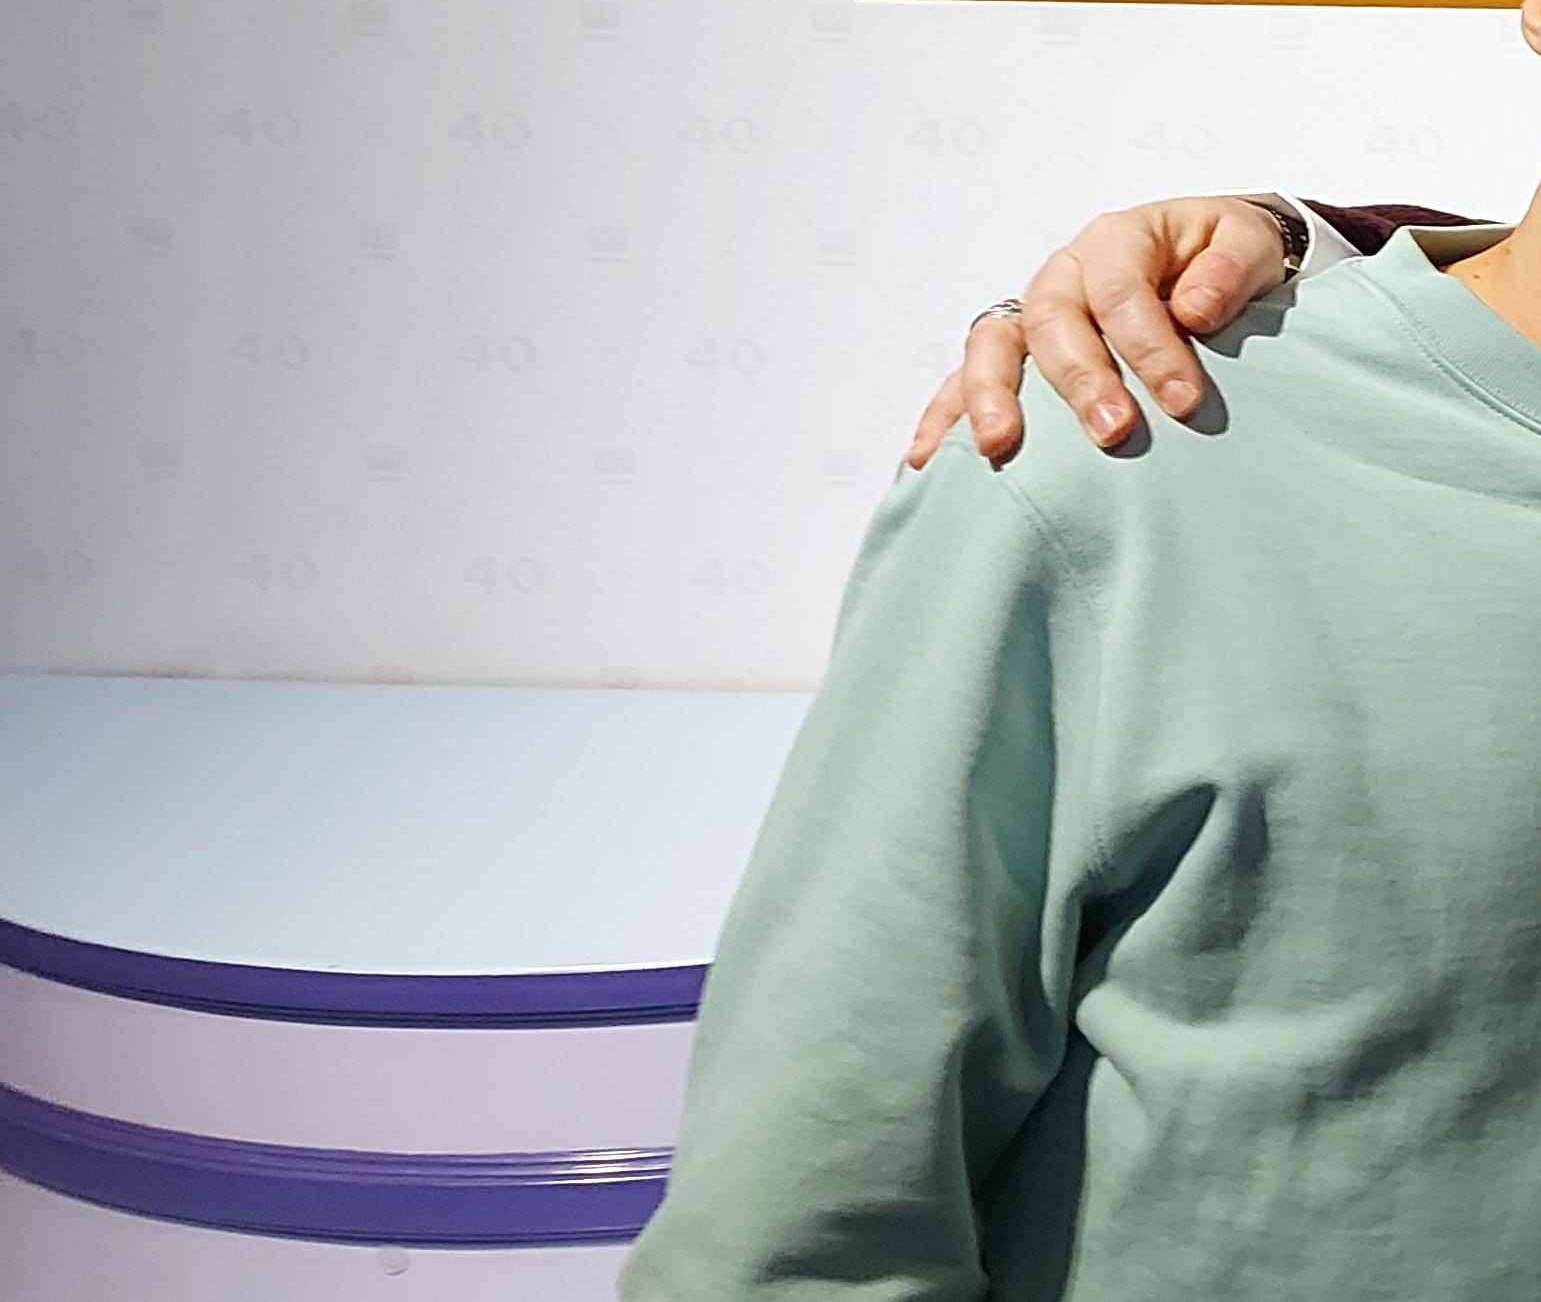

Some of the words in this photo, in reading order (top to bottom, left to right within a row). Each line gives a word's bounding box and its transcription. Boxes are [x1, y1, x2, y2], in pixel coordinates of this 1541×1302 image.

[220, 107, 302, 147] 40
[449, 111, 531, 151] 40
[679, 114, 761, 154] 40
[906, 118, 990, 159] 40
[1136, 121, 1219, 162] 40
[1364, 124, 1448, 164] 40
[3, 327, 85, 367] 40
[229, 331, 311, 371] 40
[456, 334, 538, 374] 40
[685, 336, 767, 376] 40
[13, 547, 95, 587] 40
[237, 551, 319, 591] 40
[462, 554, 544, 594] 40
[690, 556, 772, 596] 40
